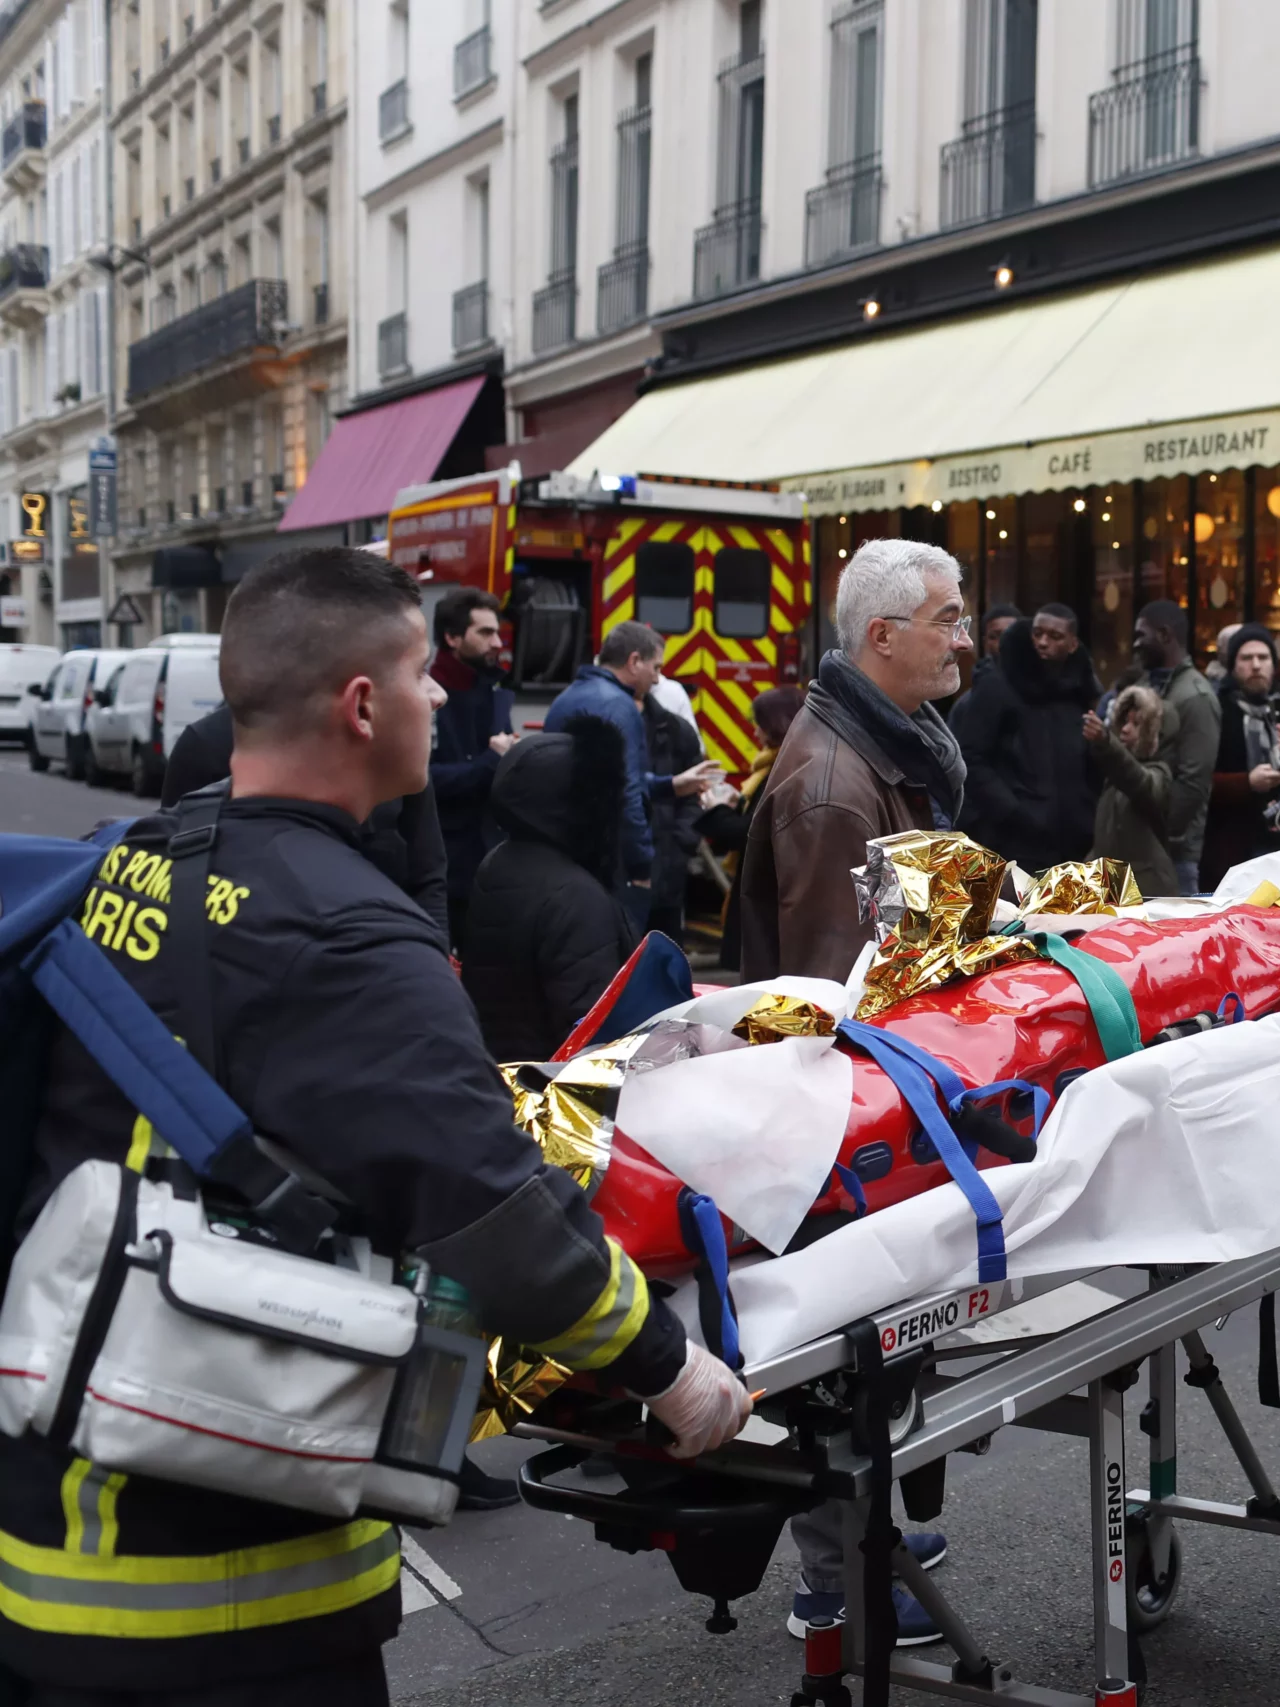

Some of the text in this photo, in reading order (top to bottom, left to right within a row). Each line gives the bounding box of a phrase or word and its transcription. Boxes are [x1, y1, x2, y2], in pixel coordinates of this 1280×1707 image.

[949, 464, 1000, 488] BISTRO
[1048, 446, 1092, 475] CAFÉ
[1144, 427, 1269, 464] RESTAURANT
[897, 1300, 959, 1347] FERNO
[968, 1288, 990, 1319] F2
[1106, 1462, 1123, 1558] FERNO
